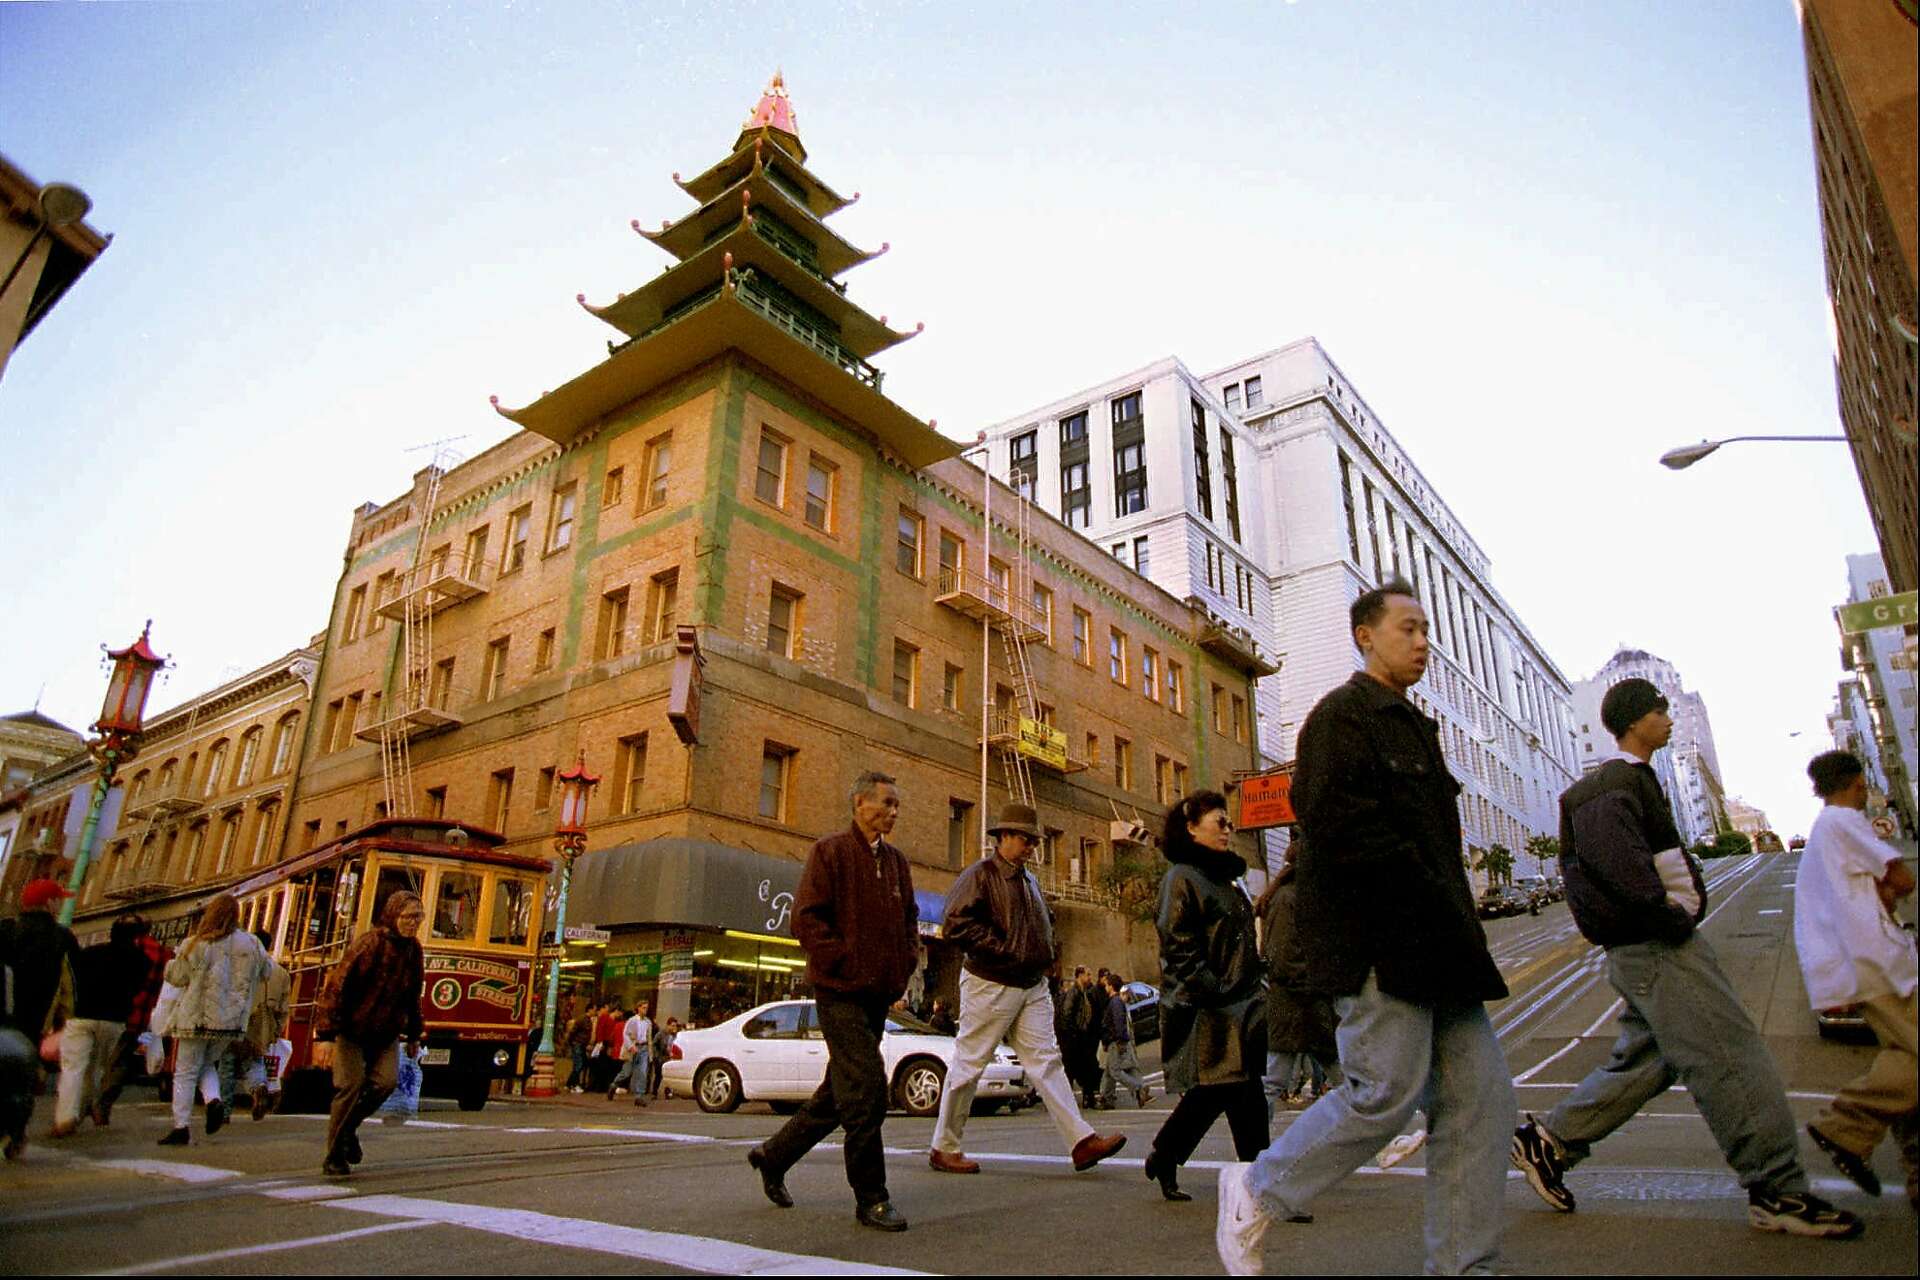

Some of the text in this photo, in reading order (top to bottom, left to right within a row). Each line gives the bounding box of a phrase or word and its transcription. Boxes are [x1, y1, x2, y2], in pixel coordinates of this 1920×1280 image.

[566, 928, 609, 941] CALIFORNIA
[457, 960, 516, 980] CALIFORNIA
[439, 984, 454, 1005] 3
